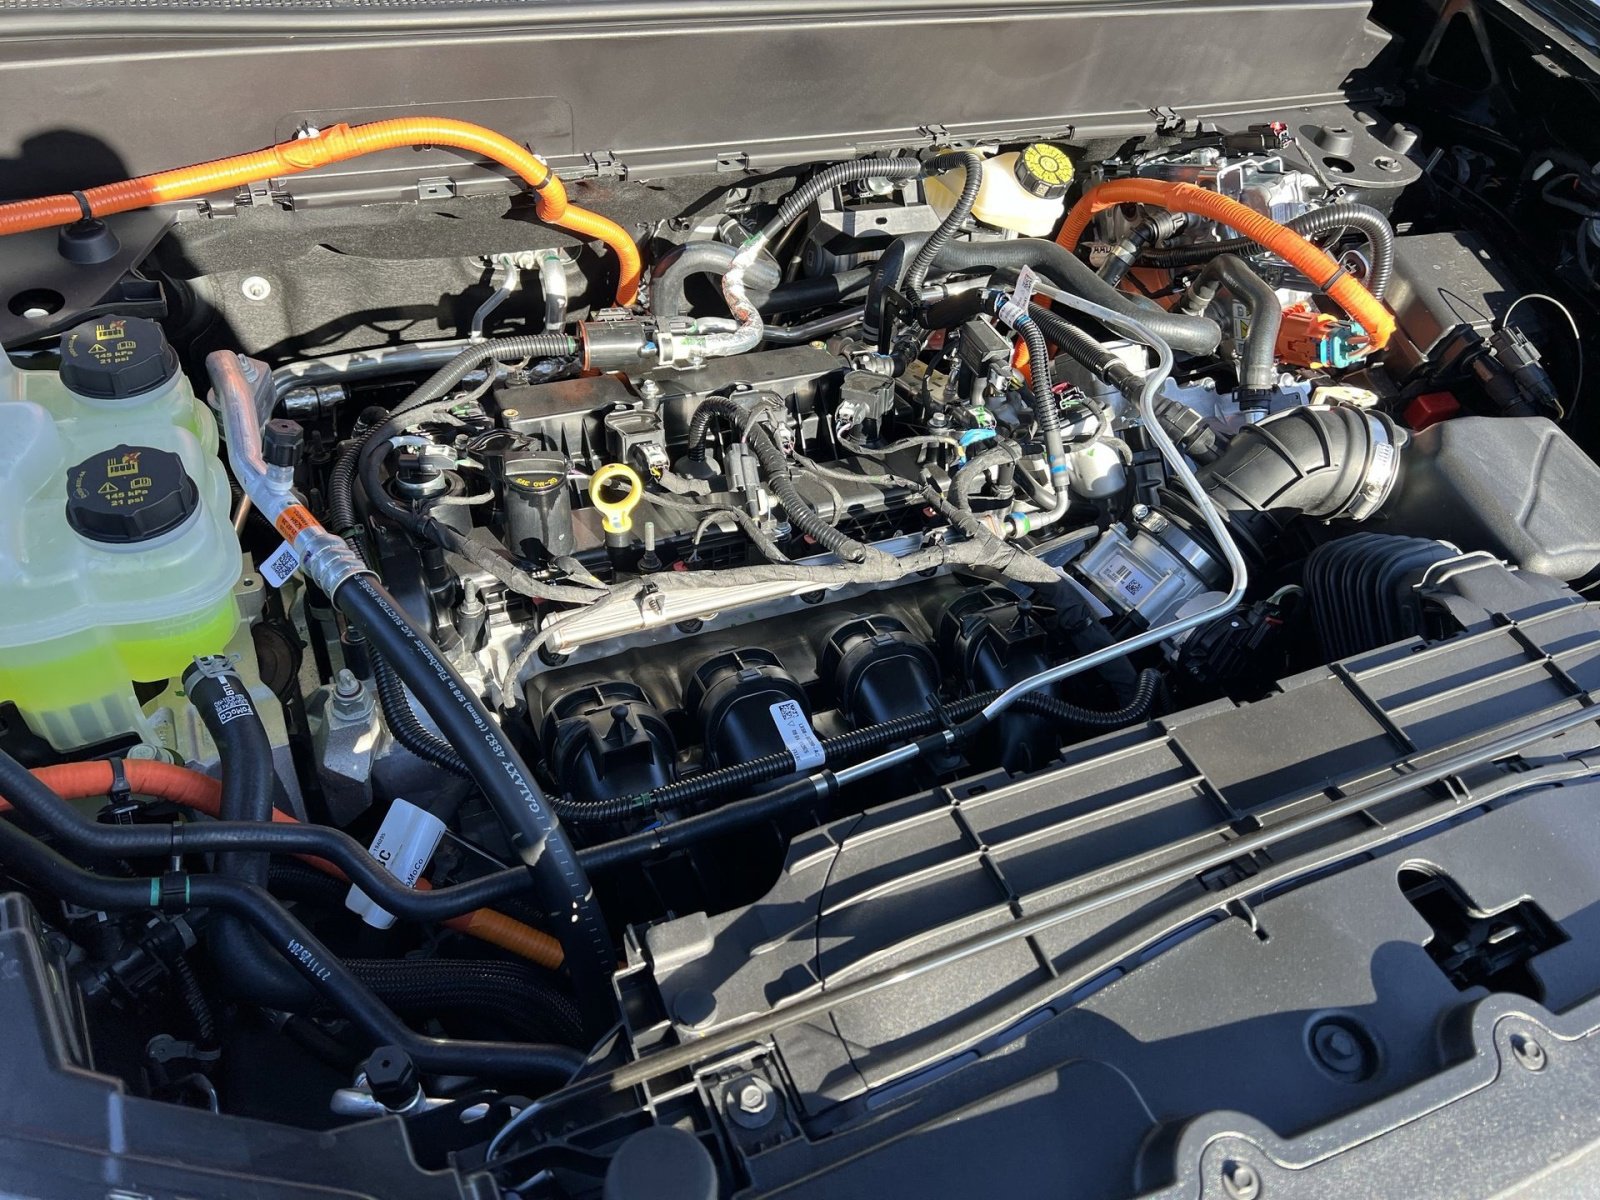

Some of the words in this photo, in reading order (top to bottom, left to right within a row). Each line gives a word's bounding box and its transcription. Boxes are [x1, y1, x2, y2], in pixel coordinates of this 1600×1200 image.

[105, 492, 125, 500] 145
[128, 489, 148, 497] kPa
[128, 496, 143, 505] psi
[359, 579, 379, 597] HOSE
[375, 596, 404, 626] SUCTION
[401, 625, 415, 637] A/C
[414, 640, 450, 681] Flexbarrier
[453, 689, 466, 702] 5/8
[463, 702, 489, 732] (16mm)
[485, 732, 505, 757] 4882
[502, 761, 540, 813] GALAXY
[405, 858, 424, 887] oMoCo
